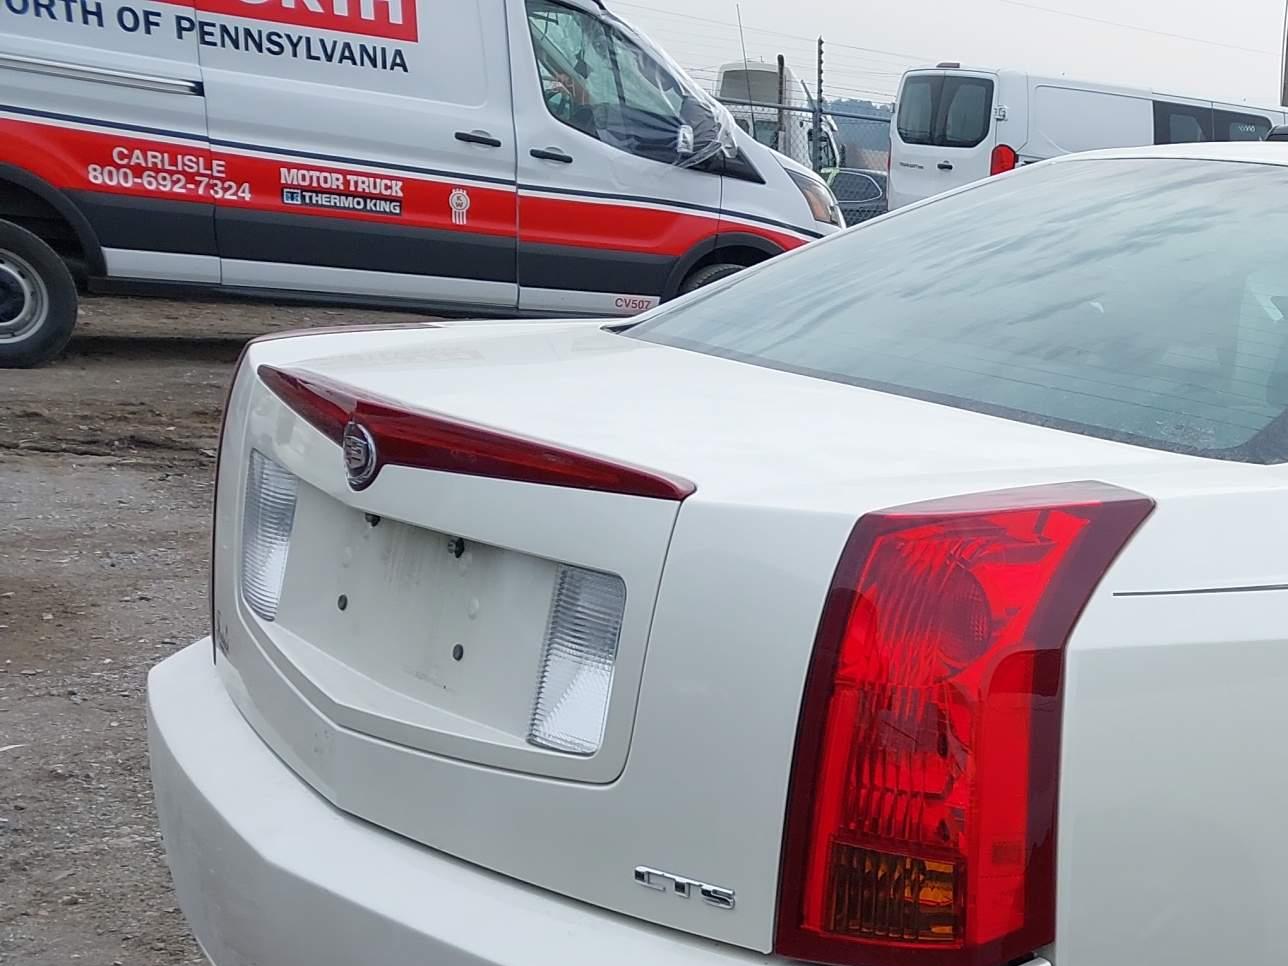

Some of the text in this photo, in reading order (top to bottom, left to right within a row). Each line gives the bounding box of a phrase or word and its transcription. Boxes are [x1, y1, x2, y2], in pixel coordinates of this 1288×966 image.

[117, 6, 162, 35] OF
[175, 14, 409, 73] PENNSYLVANIA
[112, 147, 226, 178] CARLISLE
[88, 164, 251, 201] 800-692-7324
[280, 168, 403, 197] MOTOR TRUCK
[302, 191, 365, 210] THERMO
[366, 198, 400, 214] KING
[615, 297, 651, 310] CV507
[634, 865, 736, 910] CTS
